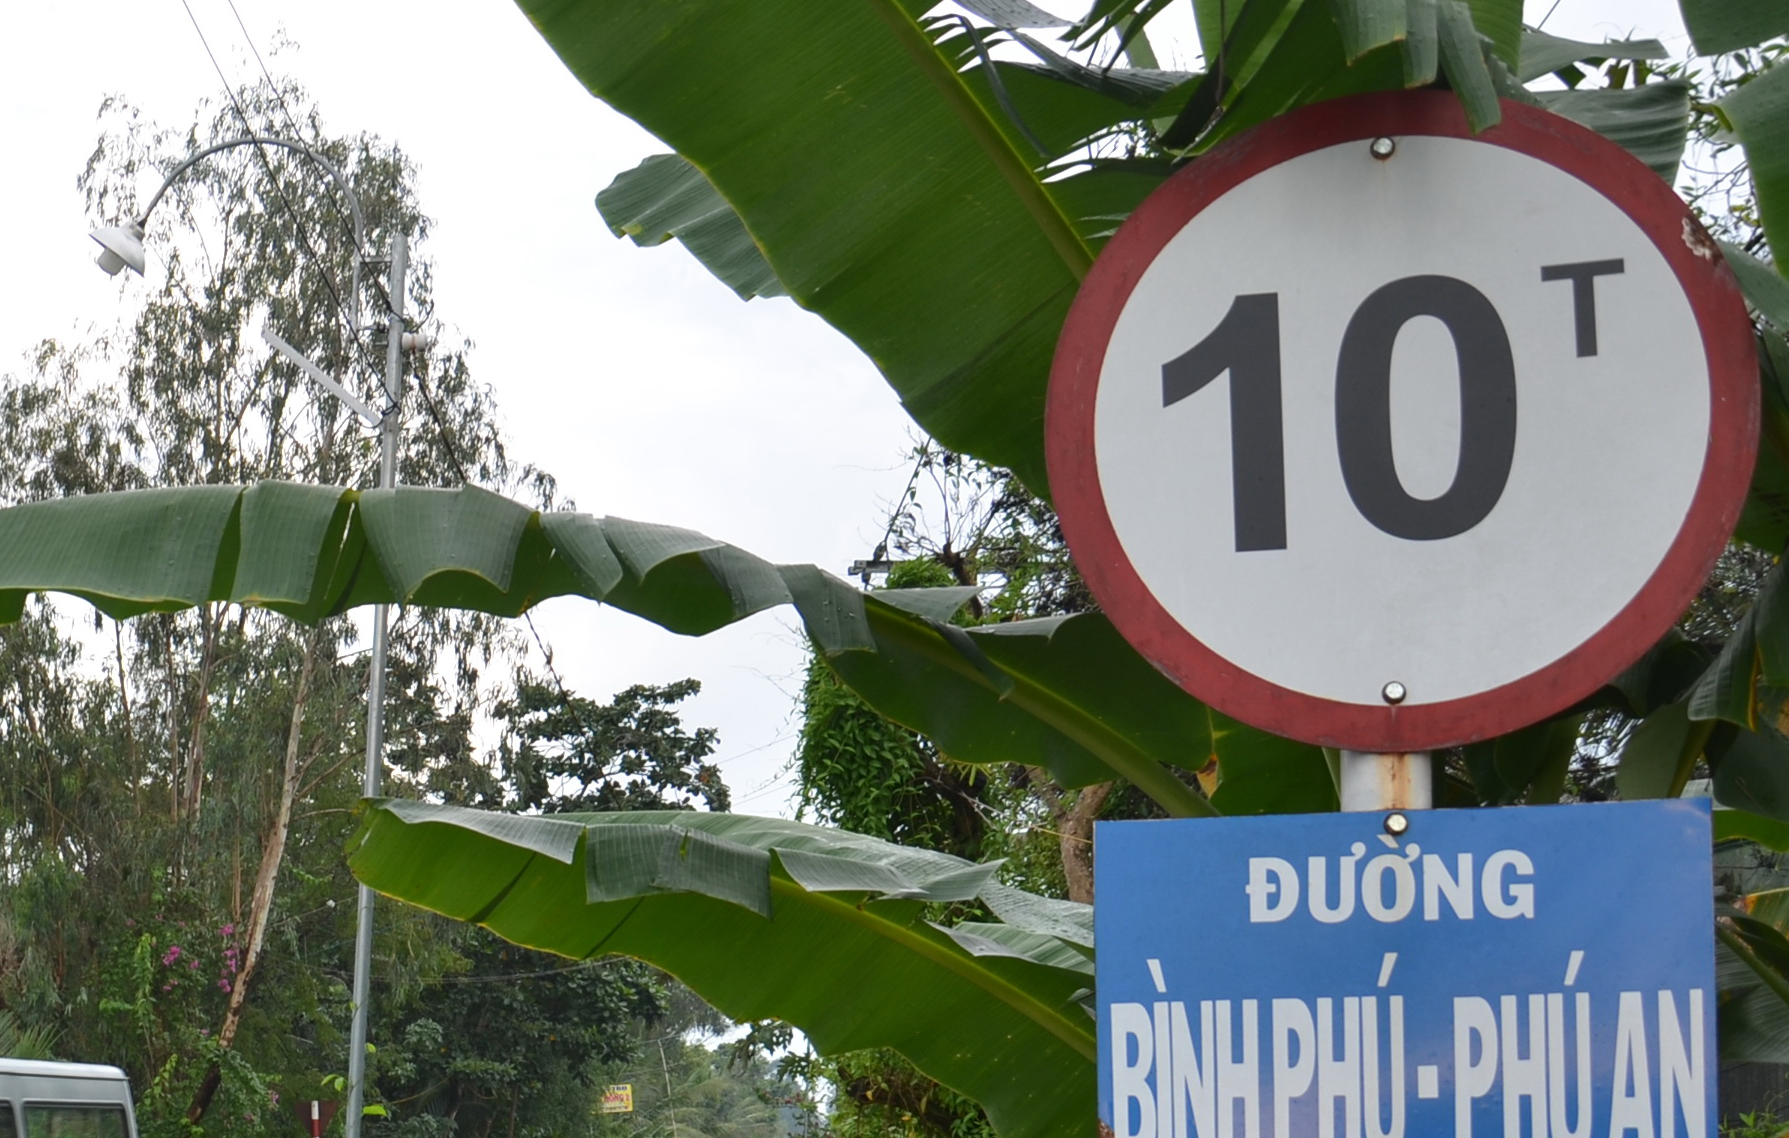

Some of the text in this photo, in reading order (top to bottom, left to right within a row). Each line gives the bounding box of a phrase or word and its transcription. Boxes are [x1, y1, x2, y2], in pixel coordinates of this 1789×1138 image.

[1161, 257, 1625, 553] 10 T
[1245, 834, 1536, 924] ĐƯỜNG
